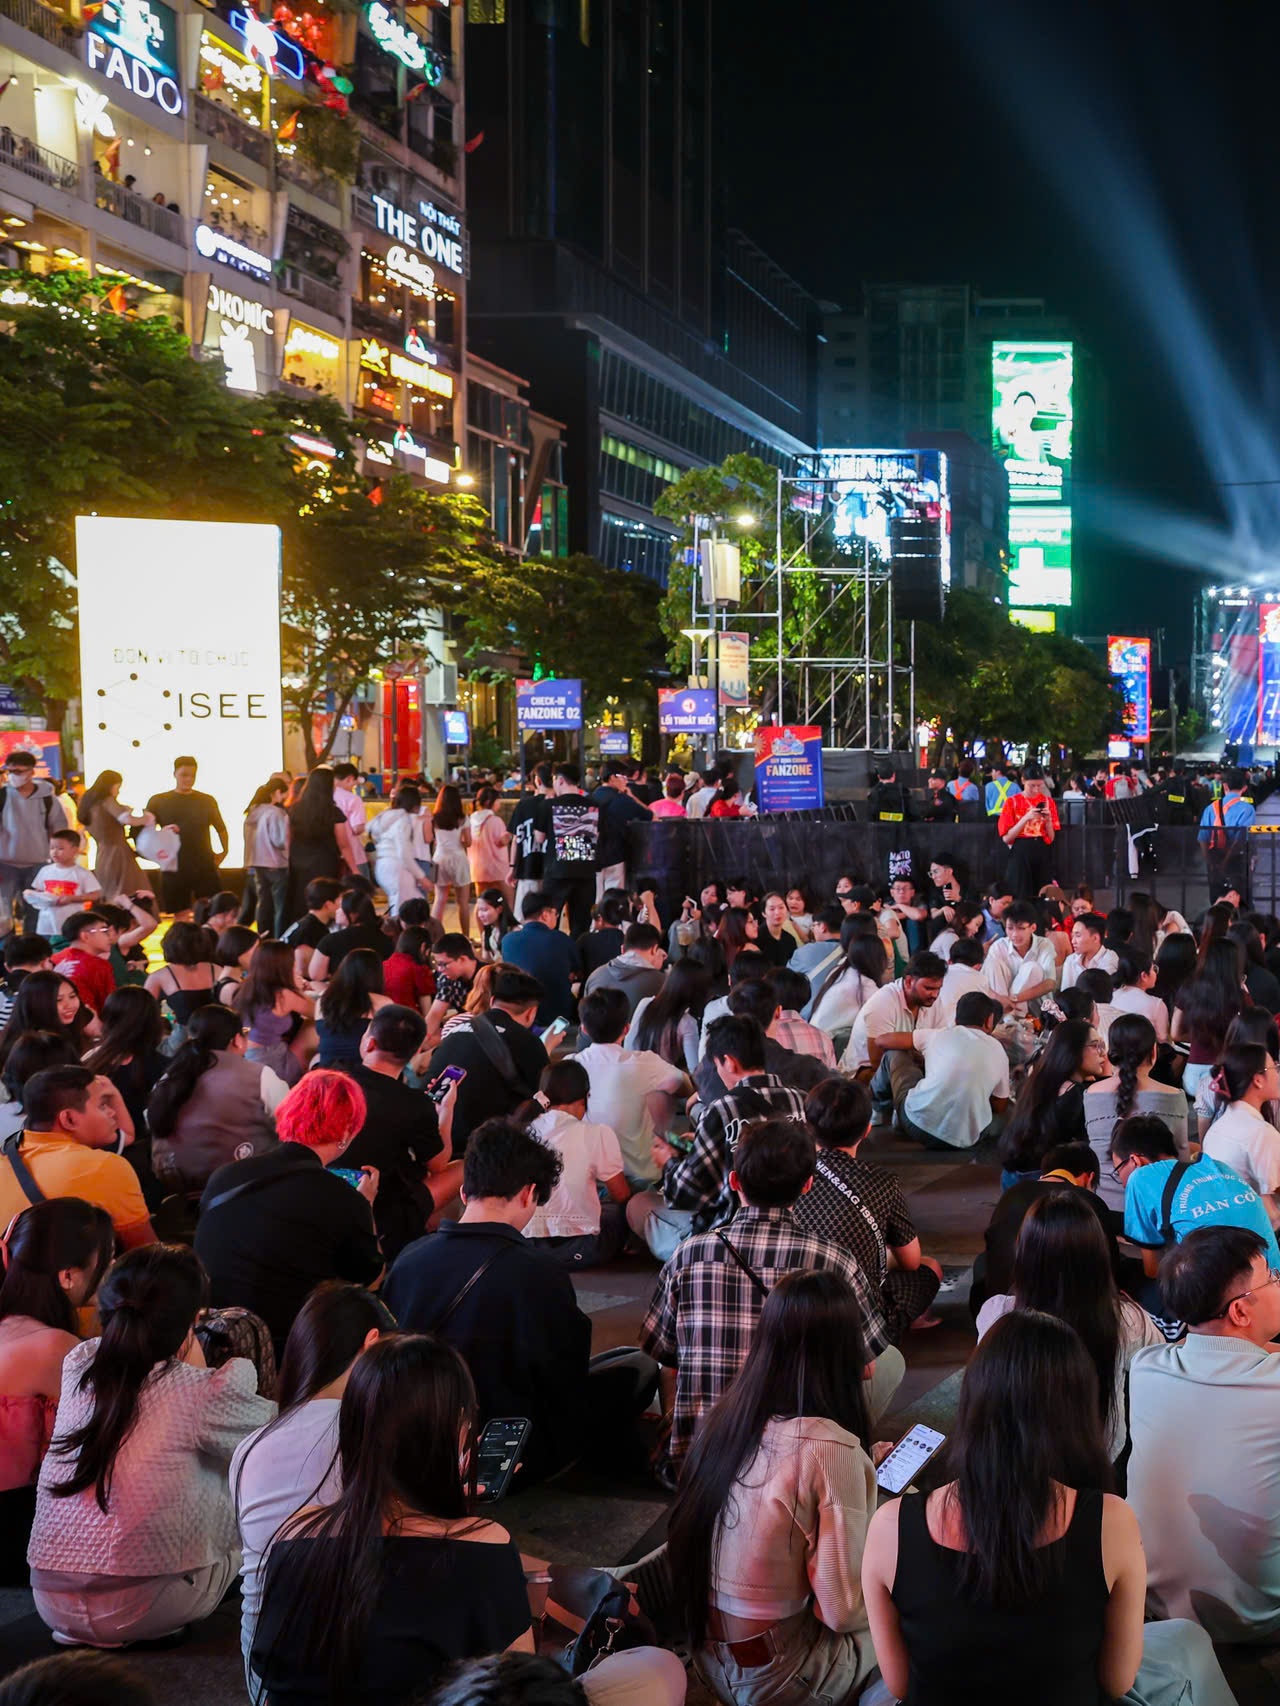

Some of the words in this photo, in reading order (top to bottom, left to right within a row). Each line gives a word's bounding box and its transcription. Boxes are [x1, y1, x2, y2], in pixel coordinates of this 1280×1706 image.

[87, 32, 183, 116] FADO
[372, 194, 417, 248] THE
[421, 226, 463, 275] ONE
[178, 693, 268, 719] ISEE
[517, 707, 565, 720] FANZONE
[566, 707, 581, 720] 02
[766, 763, 814, 777] FANZONE
[1191, 1200, 1231, 1219] BÀN
